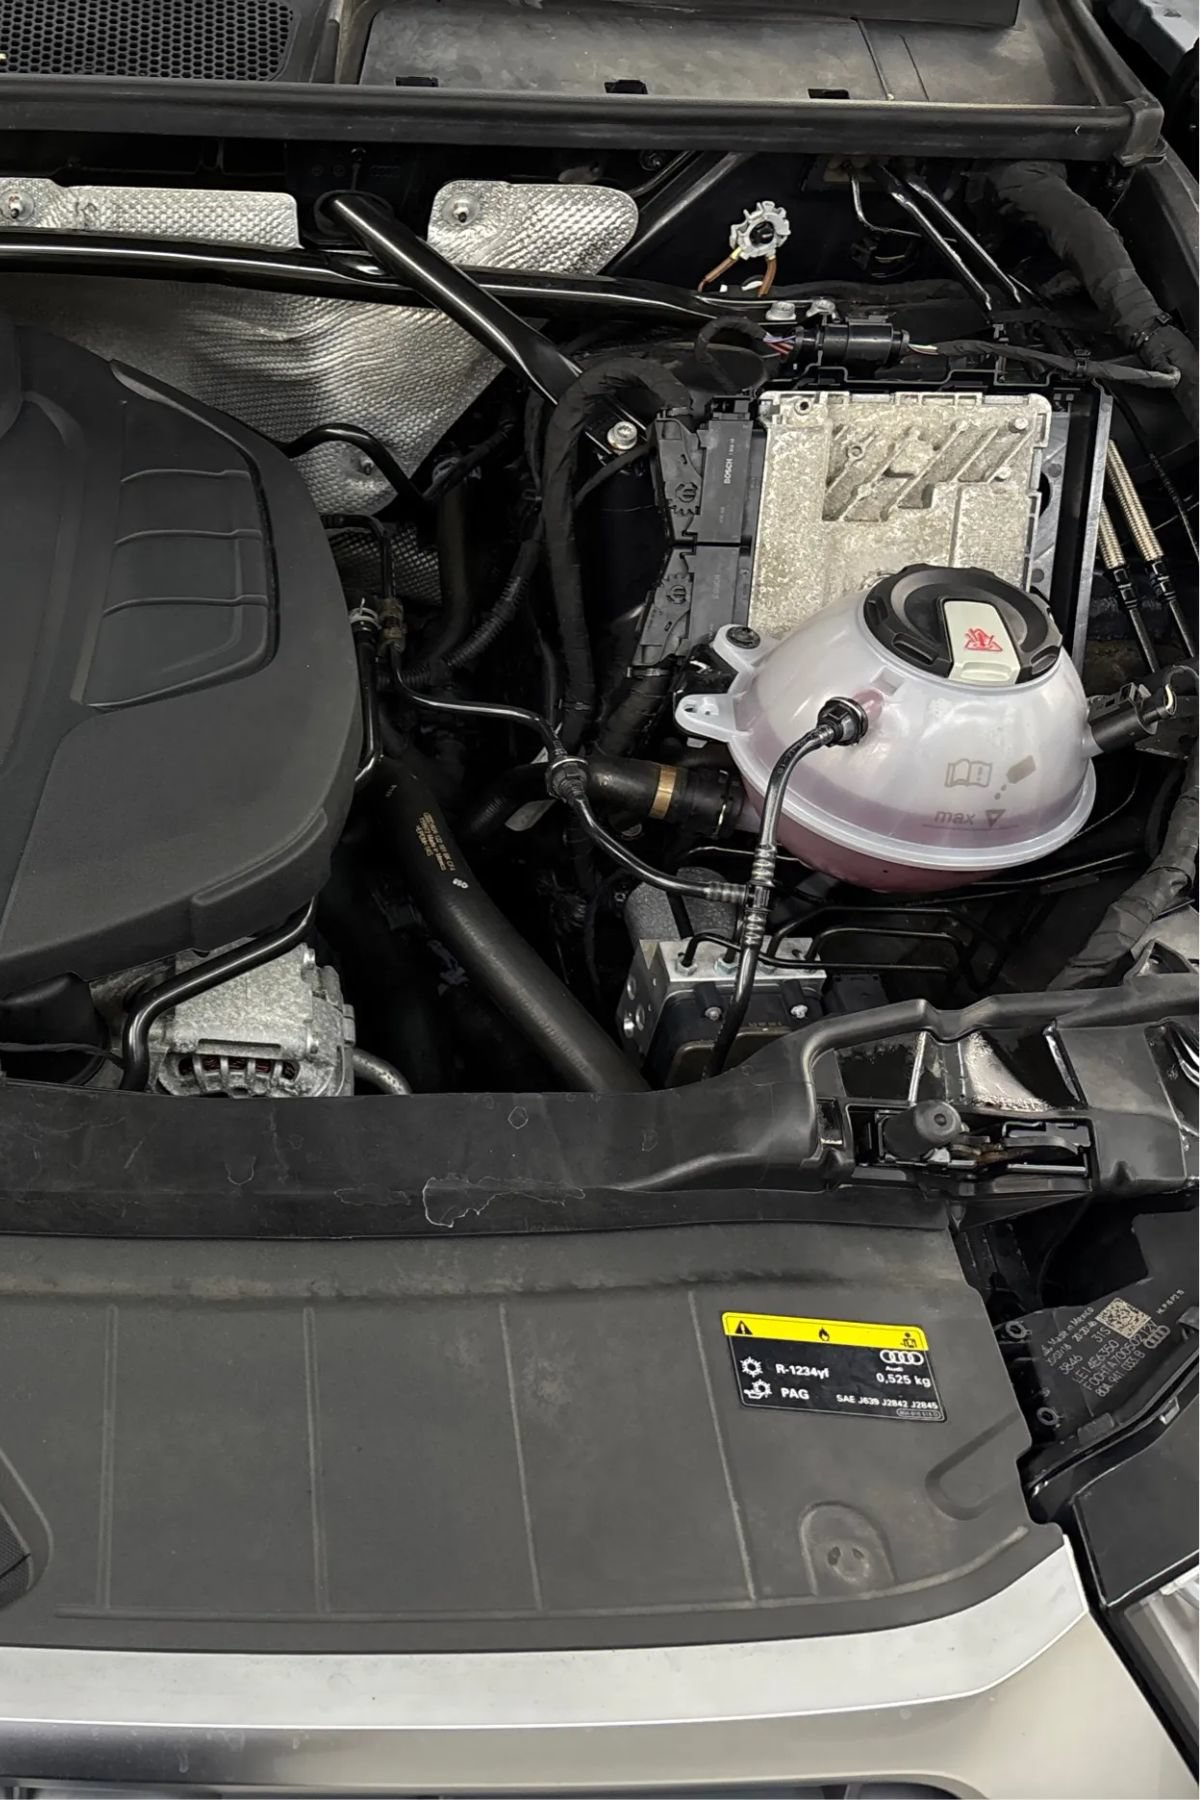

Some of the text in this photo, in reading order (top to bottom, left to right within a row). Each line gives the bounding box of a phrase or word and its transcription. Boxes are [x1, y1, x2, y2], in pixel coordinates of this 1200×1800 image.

[934, 810, 976, 826] max
[1070, 1305, 1094, 1325] Mexico
[1058, 1352, 1083, 1374] 3846
[774, 1363, 932, 1388] R-1234yf 0,525 kg
[780, 1387, 939, 1410] PAG SAE J639 J2842 J2845
